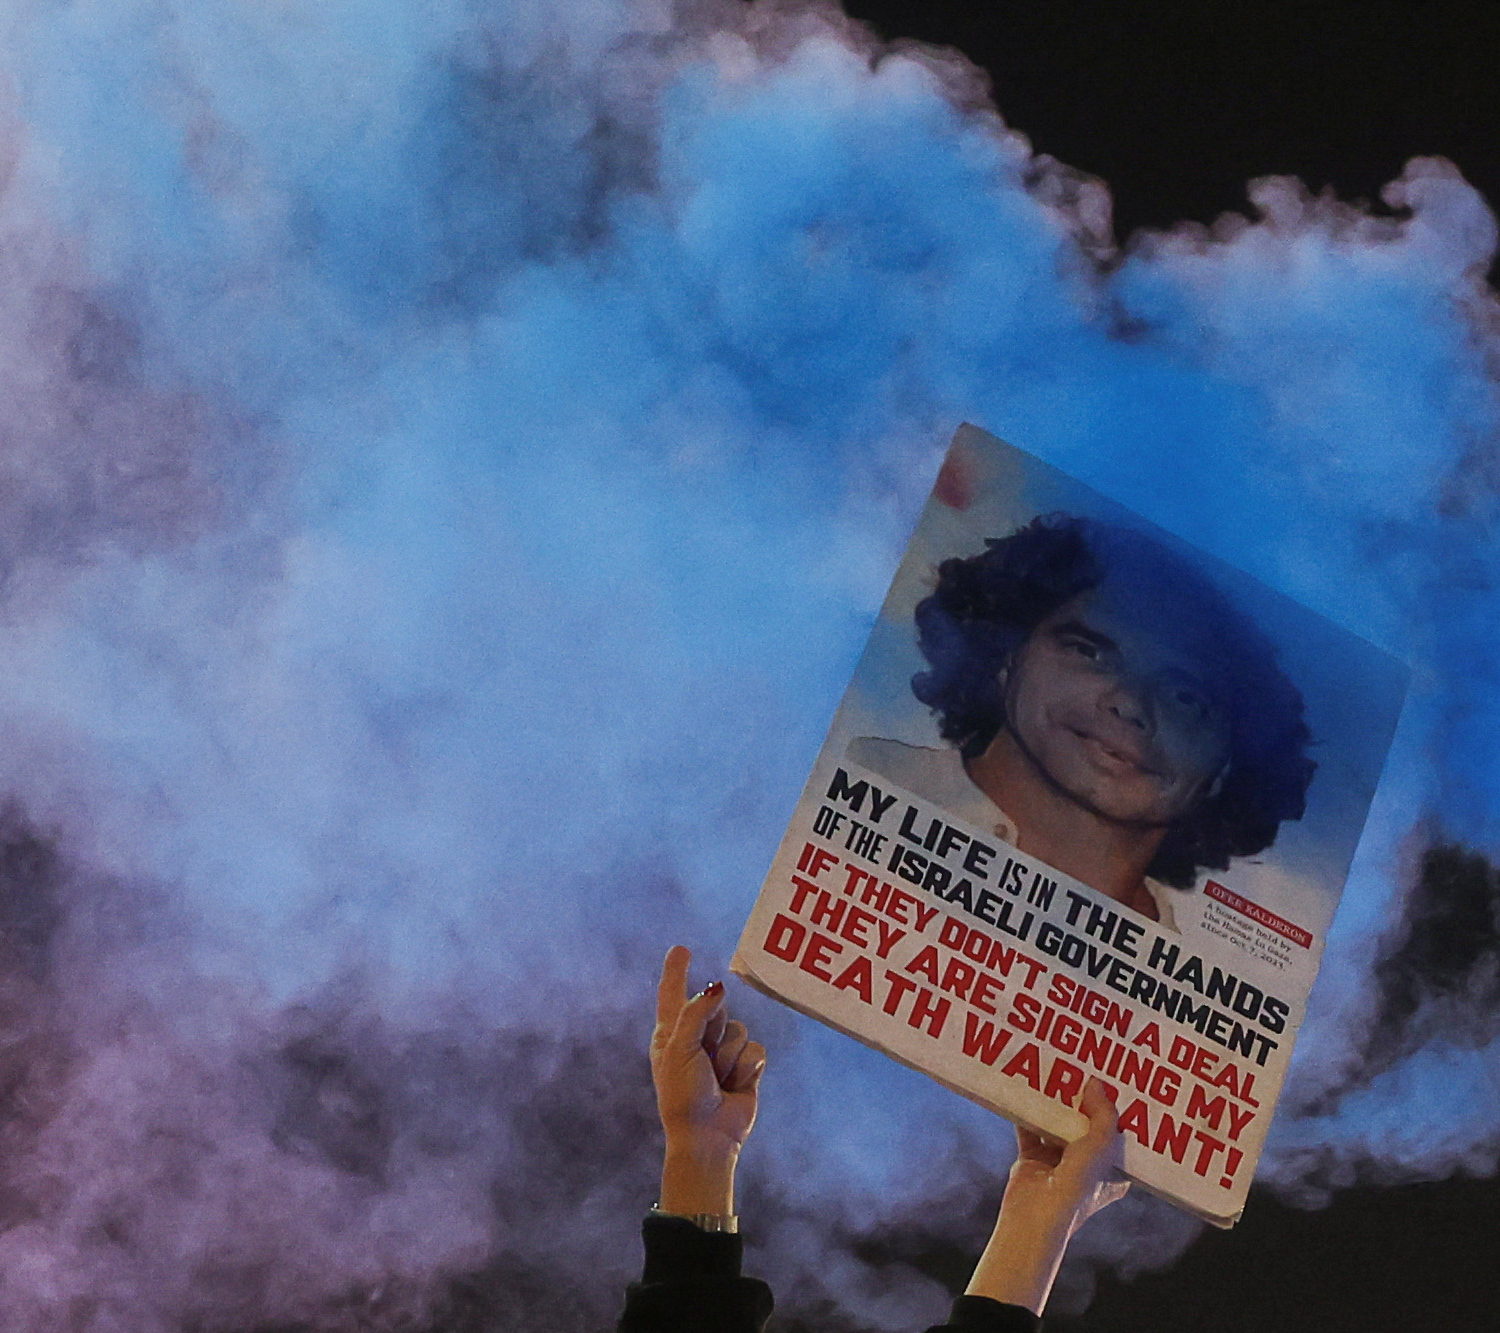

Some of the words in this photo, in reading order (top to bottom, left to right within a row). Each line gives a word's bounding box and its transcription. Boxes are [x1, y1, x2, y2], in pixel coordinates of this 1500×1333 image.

[763, 912, 952, 1039] DEATH
[789, 875, 906, 959] THEY
[904, 945, 1005, 1015] ARE
[1007, 993, 1182, 1107] SIGNING
[1186, 1084, 1257, 1141] MY
[796, 842, 840, 878] IF
[845, 863, 940, 933] THEY
[938, 916, 1048, 989] DON'T
[1047, 972, 1134, 1038] SIGN
[1132, 1022, 1160, 1056] A
[1168, 1035, 1259, 1107] DEAL
[812, 805, 847, 840] OF
[844, 820, 888, 864] THE
[887, 844, 1035, 941] ISRAELI
[1035, 922, 1278, 1067] GOVERNMENT
[826, 767, 898, 823] MY
[898, 806, 997, 879] LIFE
[999, 858, 1028, 895] IS
[1027, 873, 1057, 912] IN
[1065, 890, 1145, 958] THE
[1148, 936, 1290, 1035] HANDS
